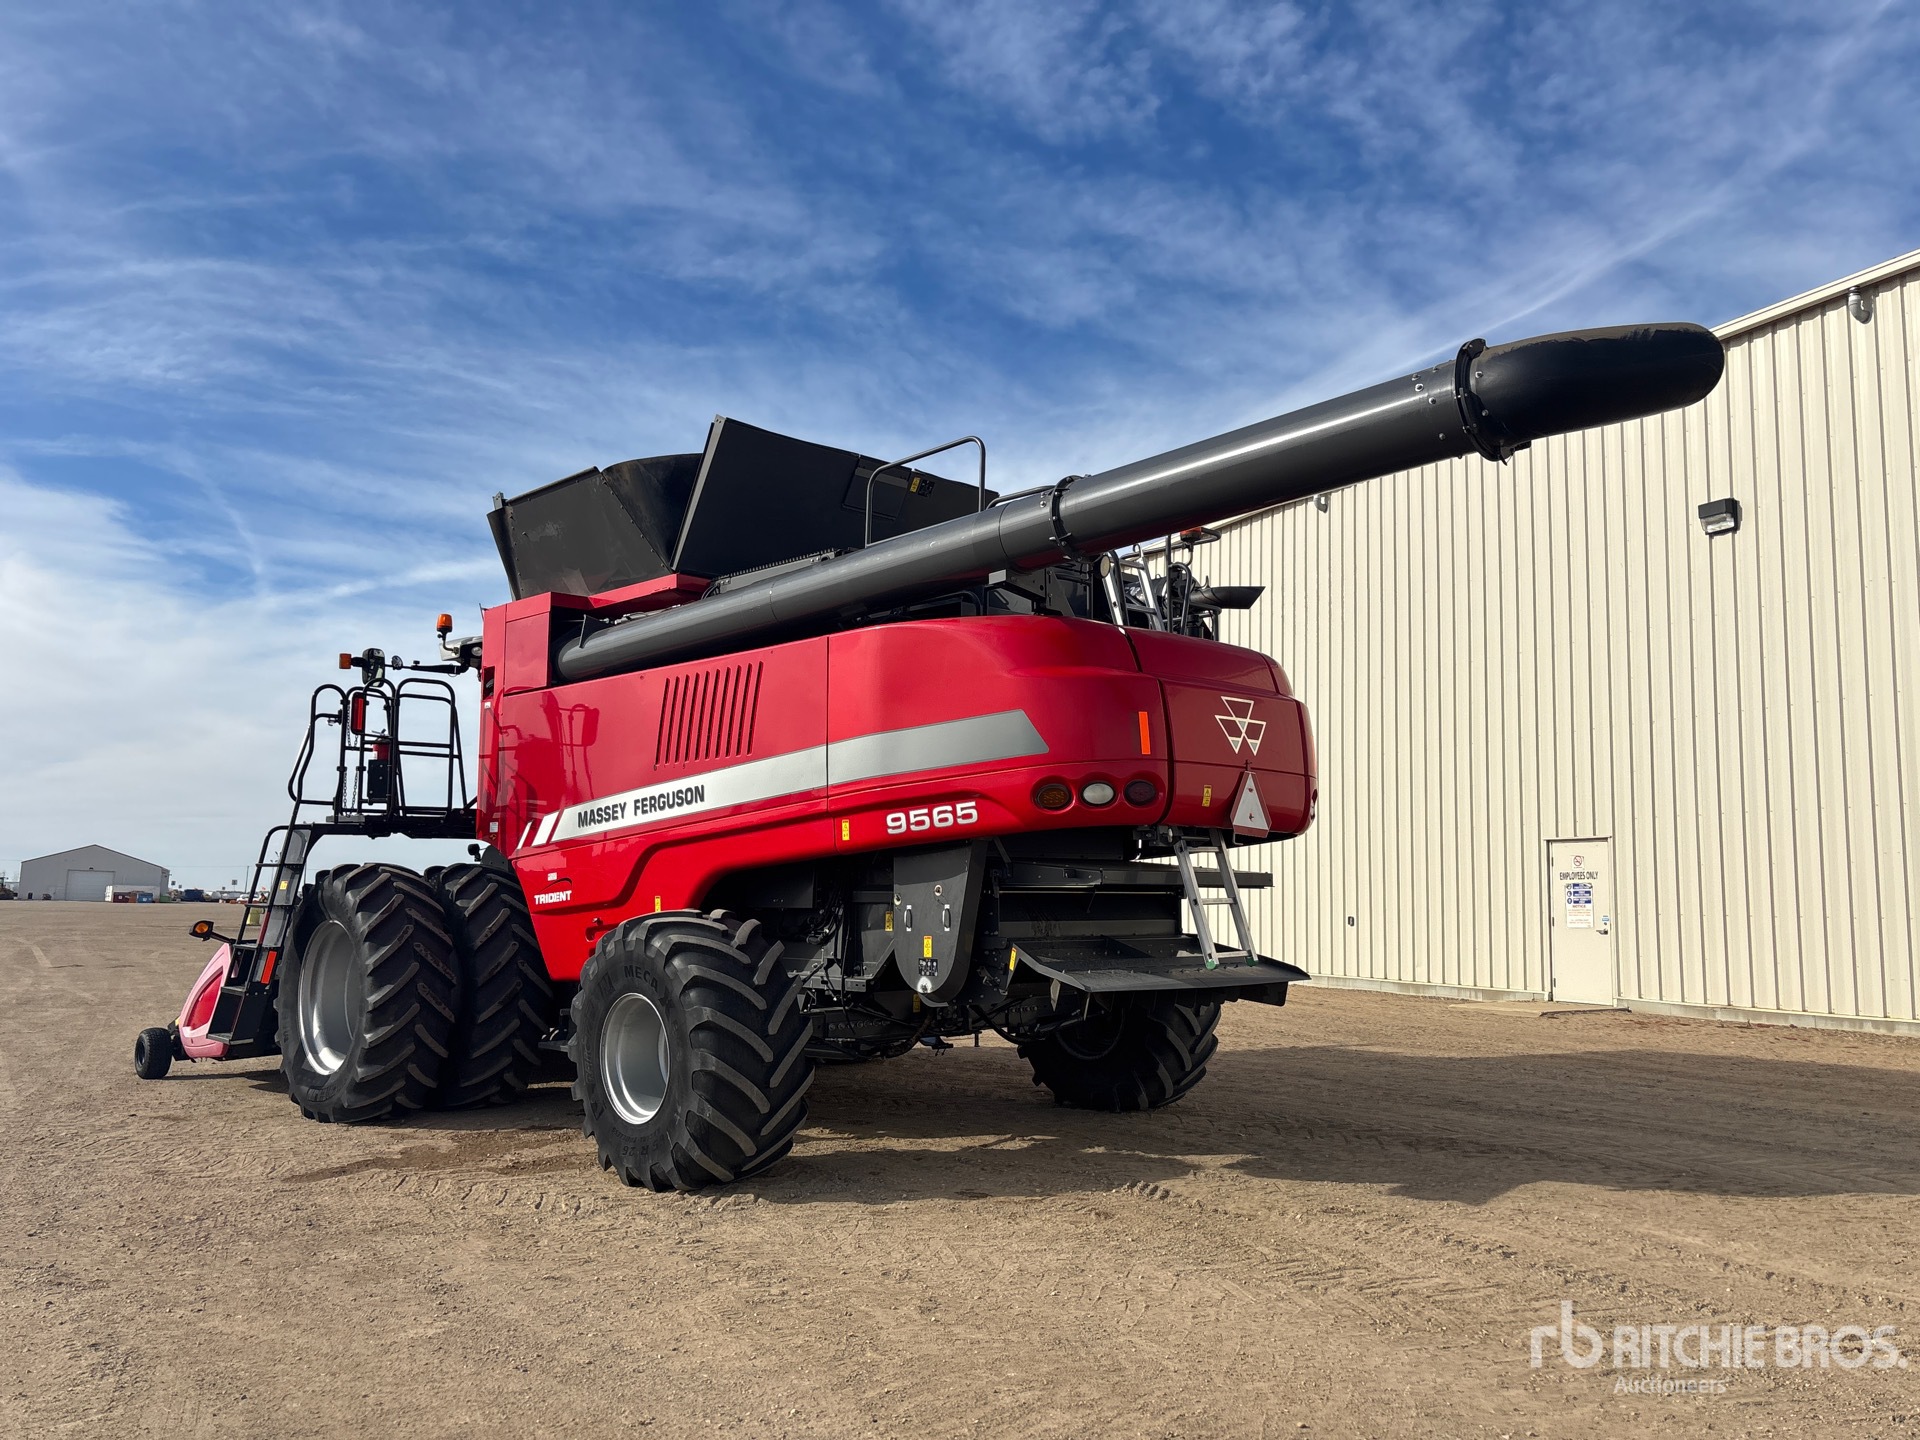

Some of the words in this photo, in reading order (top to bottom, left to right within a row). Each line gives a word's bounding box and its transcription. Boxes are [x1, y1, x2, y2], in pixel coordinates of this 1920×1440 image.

[577, 801, 627, 828] MASSEY
[633, 784, 705, 816] FERGUSON
[886, 801, 978, 835] 9565
[1559, 871, 1585, 880] EMPLOYEES
[1586, 871, 1598, 880] ONLY
[533, 890, 572, 905] TRIDENT
